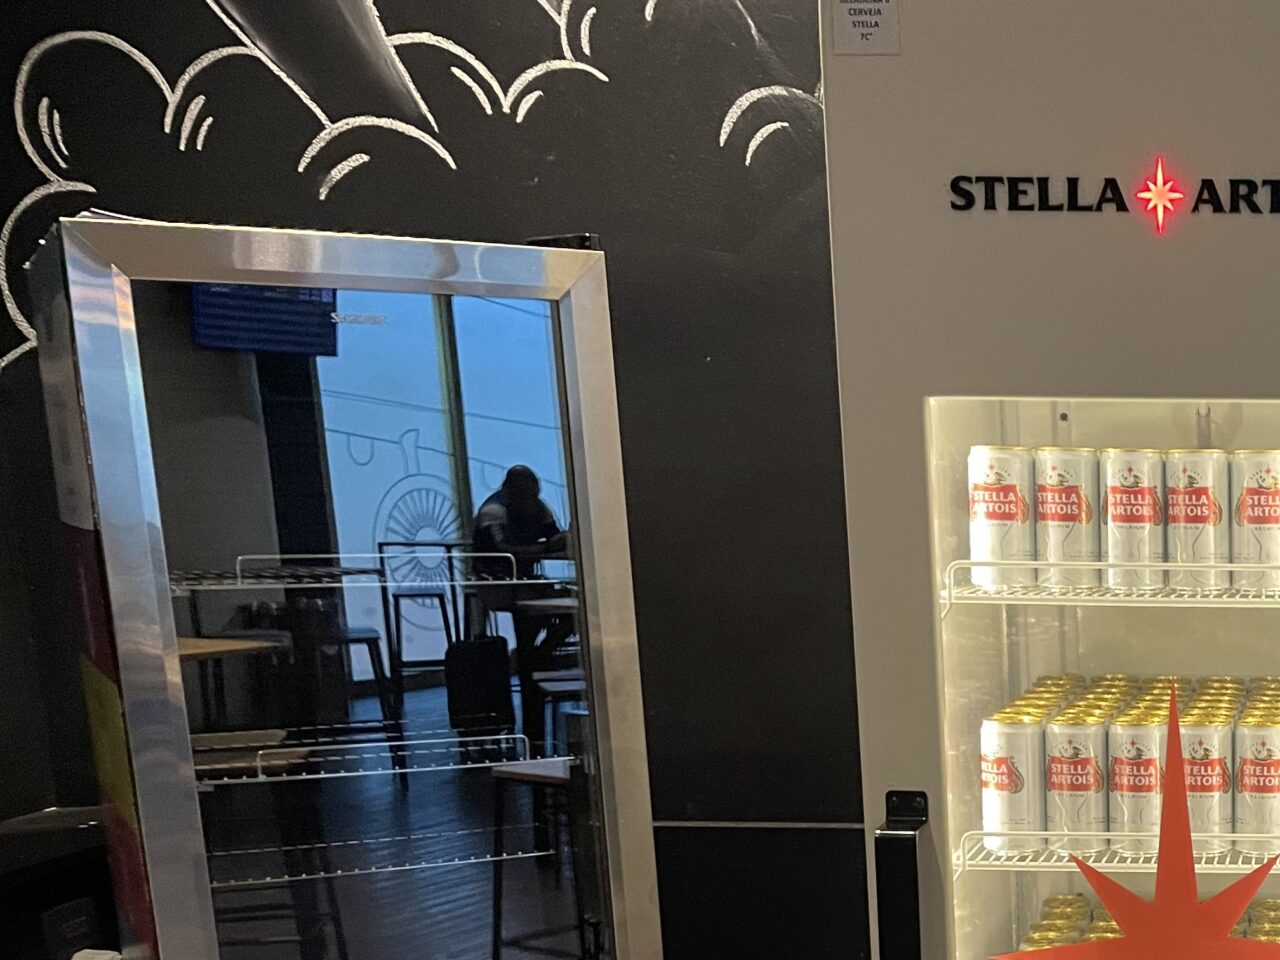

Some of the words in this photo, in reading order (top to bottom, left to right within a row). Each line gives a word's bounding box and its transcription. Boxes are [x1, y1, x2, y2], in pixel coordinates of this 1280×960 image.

[848, 7, 882, 17] CERVEJA
[852, 20, 880, 29] STELLA
[949, 175, 1130, 213] STELLA
[973, 491, 1016, 502] STELLA
[1037, 492, 1079, 503] STELLA
[1109, 493, 1153, 504] STELLA
[1168, 494, 1208, 505] STELLA
[971, 502, 1017, 514] ARTOIS
[1037, 503, 1079, 515] ARTOIS
[1109, 504, 1154, 516] ARTOIS
[1168, 505, 1209, 517] ARTOIS
[1051, 764, 1093, 774] STELLA
[1114, 765, 1155, 775] STELLA
[1184, 765, 1222, 775] TELLA
[1050, 774, 1094, 785] ARTOIS
[1114, 775, 1156, 785] ARTOIS
